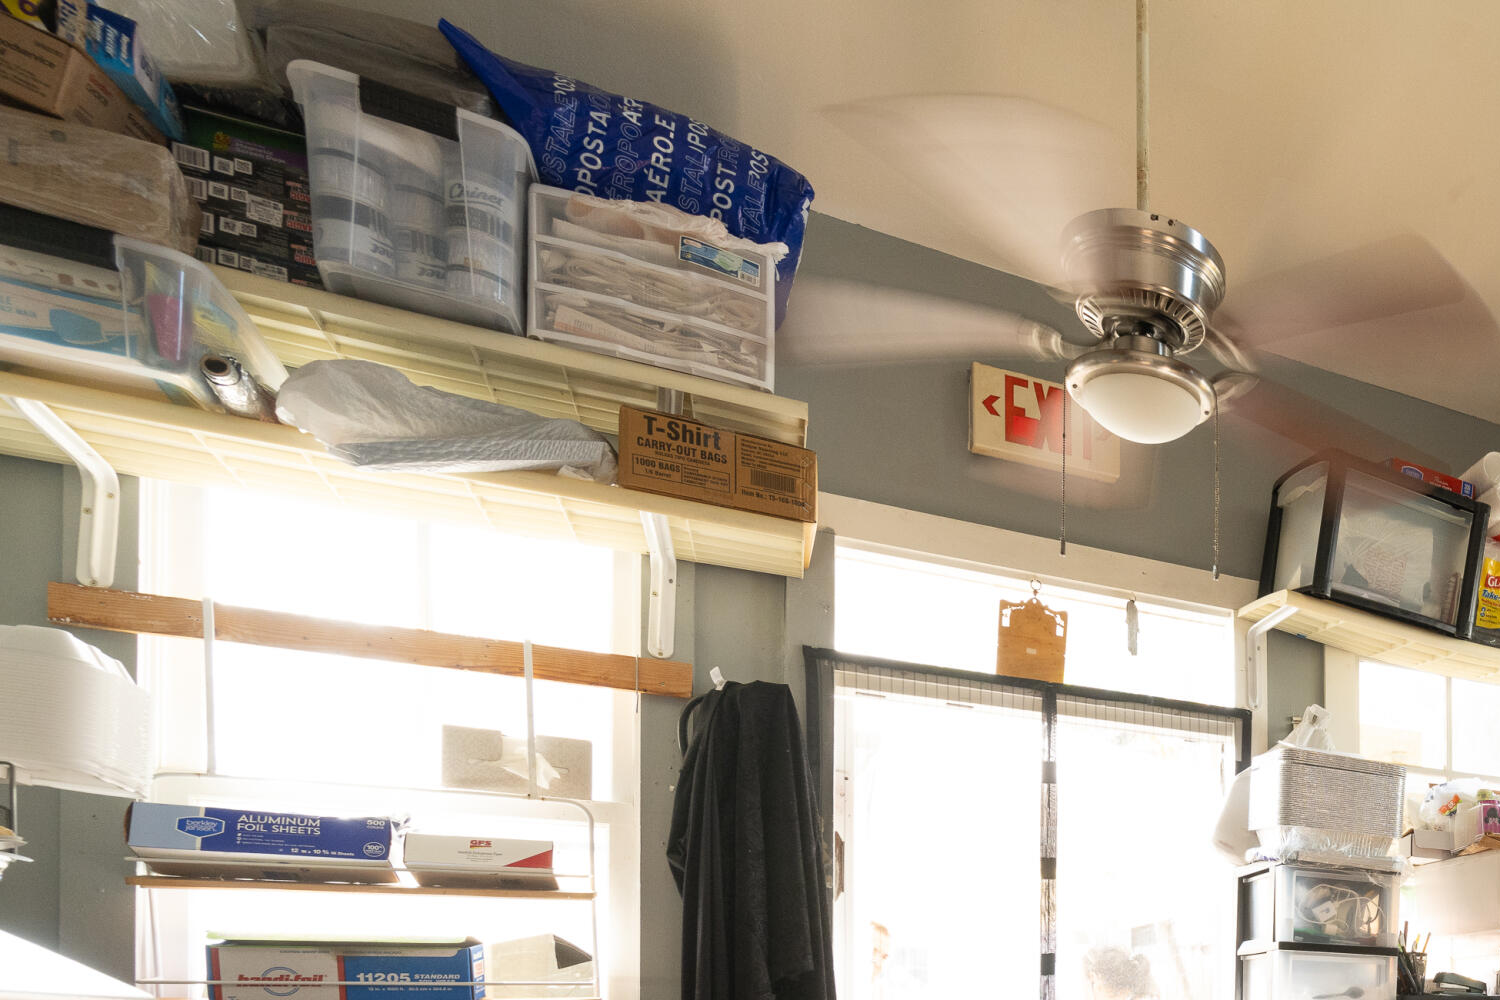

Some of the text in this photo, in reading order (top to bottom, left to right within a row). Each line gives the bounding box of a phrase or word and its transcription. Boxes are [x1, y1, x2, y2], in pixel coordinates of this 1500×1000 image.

[643, 415, 721, 450] T-Shirt
[637, 436, 697, 458] CARRY-OUT
[700, 450, 728, 465] BAGS
[635, 456, 681, 472] 1000 BAGS
[237, 814, 321, 828] ALUMINUM
[236, 823, 321, 836] FOIL SHEETS
[356, 973, 411, 985] 11205
